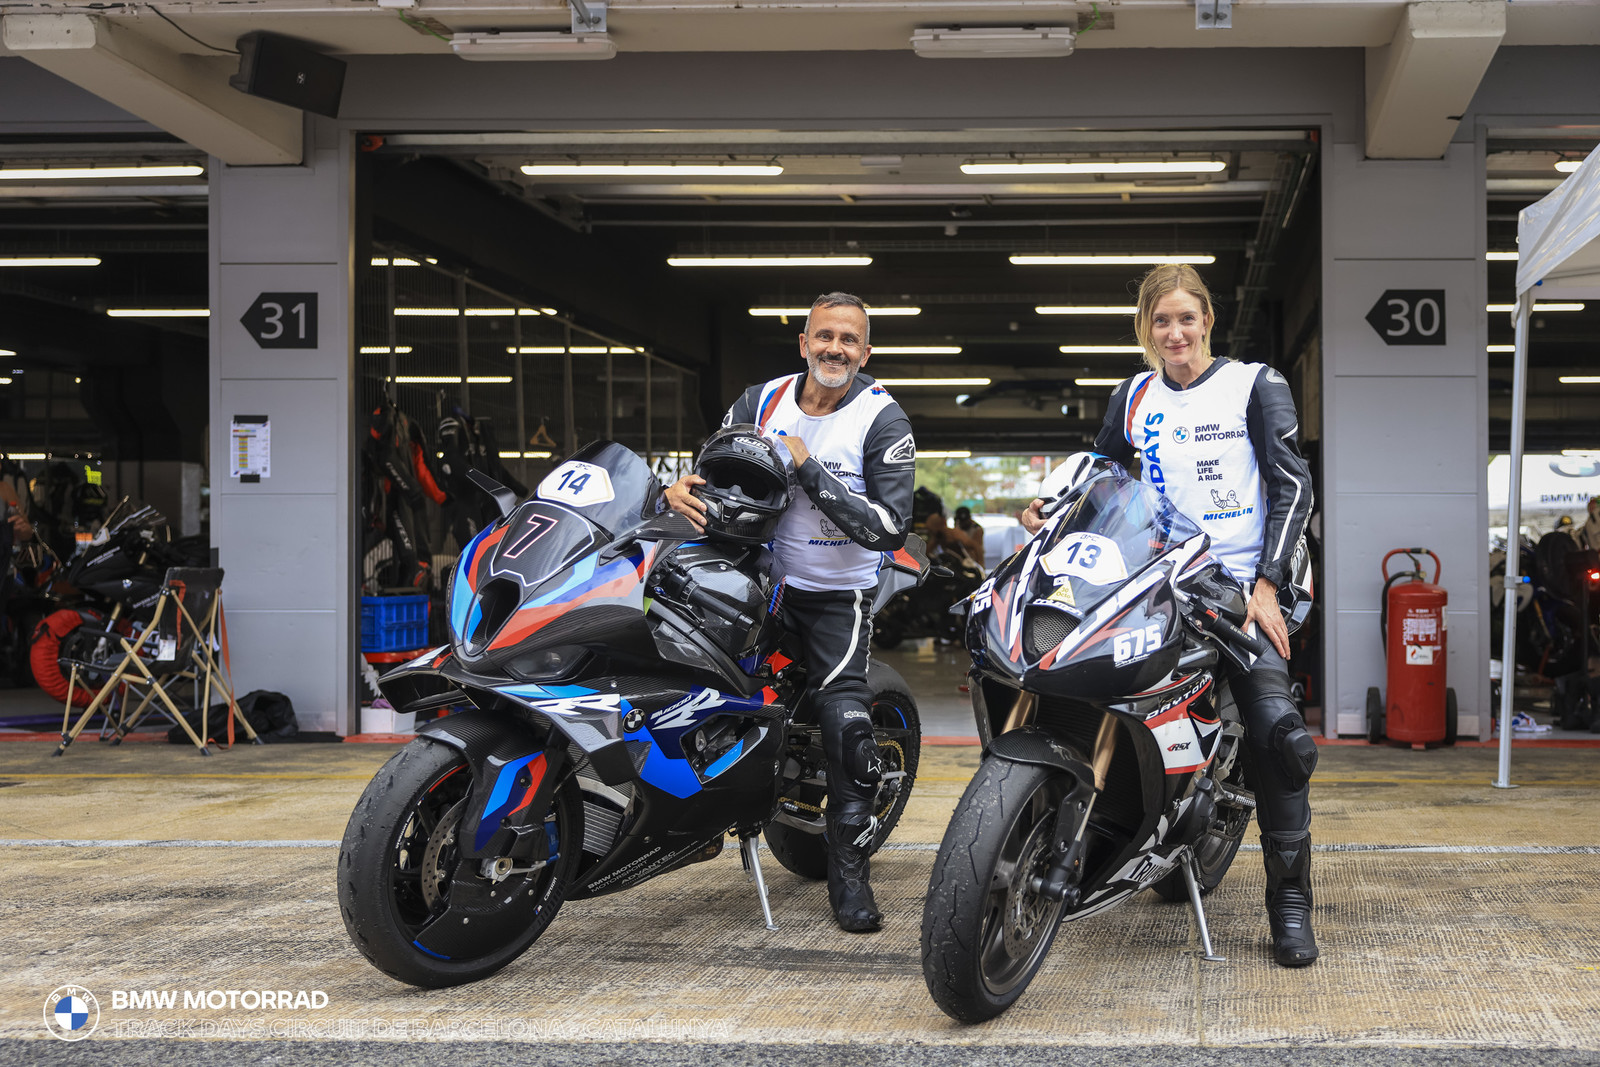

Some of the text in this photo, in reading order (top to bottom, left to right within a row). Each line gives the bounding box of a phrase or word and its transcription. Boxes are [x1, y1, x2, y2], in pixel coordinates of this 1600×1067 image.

[261, 302, 306, 340] 31
[1387, 298, 1440, 337] 30
[1194, 430, 1246, 442] MOTORRAD
[1195, 424, 1220, 433] BMW
[820, 461, 842, 470] MW
[1197, 467, 1213, 475] LIFE
[557, 470, 592, 495] 14
[1203, 507, 1254, 521] MICHELIN
[503, 513, 559, 559] 7
[1067, 542, 1102, 569] 13
[1113, 624, 1162, 662] 675
[587, 875, 611, 889] BMW
[611, 846, 662, 876] MOTORRAD
